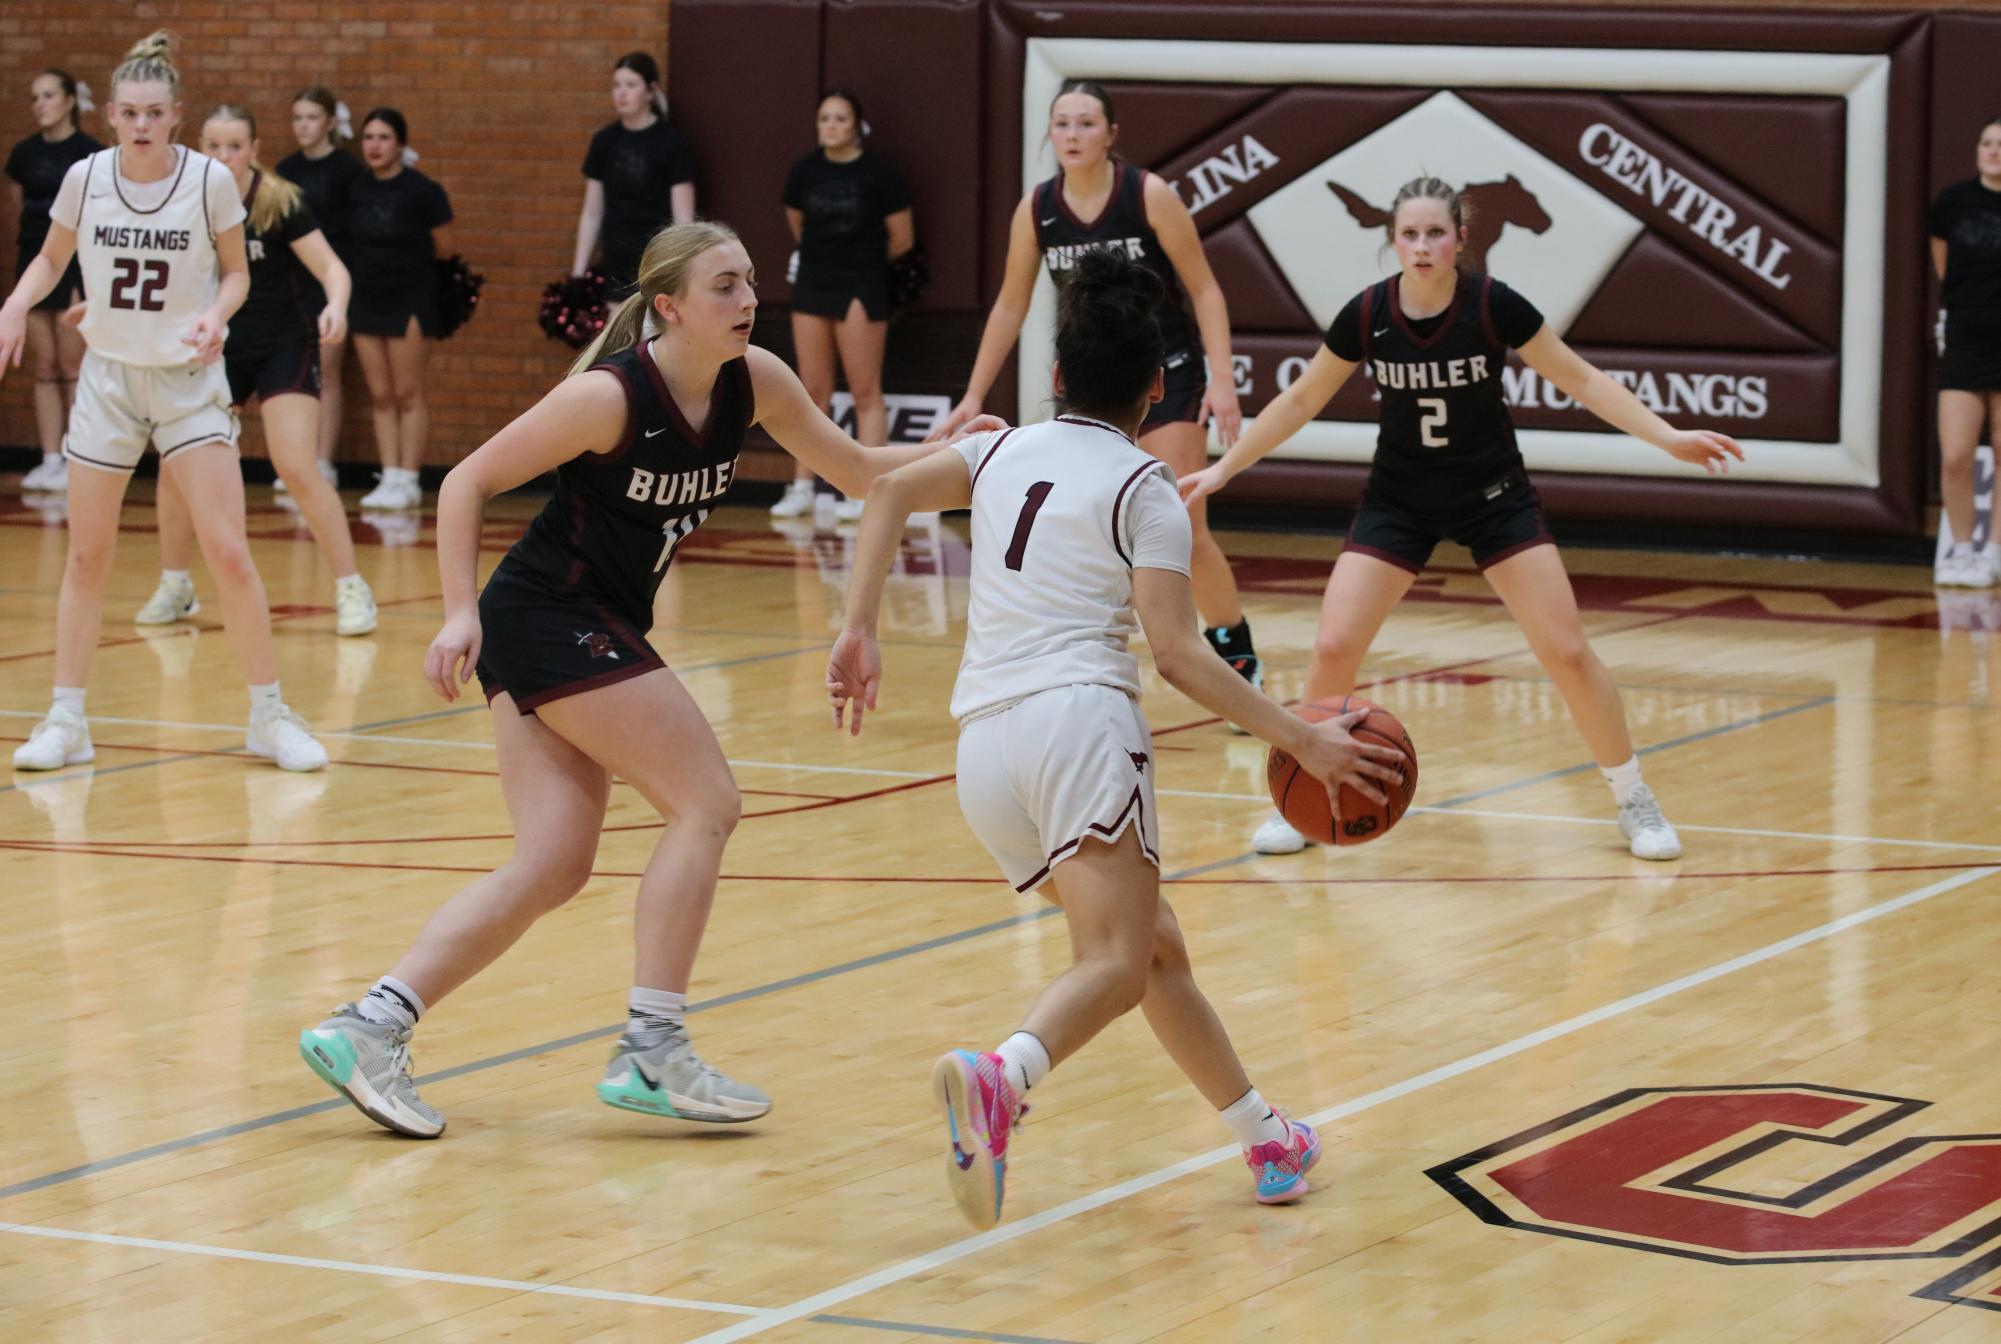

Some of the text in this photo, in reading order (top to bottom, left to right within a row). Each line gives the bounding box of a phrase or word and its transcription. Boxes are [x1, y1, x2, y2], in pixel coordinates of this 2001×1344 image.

[1578, 122, 1792, 290] CENTRAL
[93, 225, 190, 250] MUSTANGS
[110, 257, 169, 311] 22
[1372, 354, 1489, 390] BUHLER
[1500, 366, 1768, 419] MUTANGS
[1417, 398, 1449, 447] 2
[626, 454, 739, 506] BUHLE
[1004, 480, 1055, 572] 1
